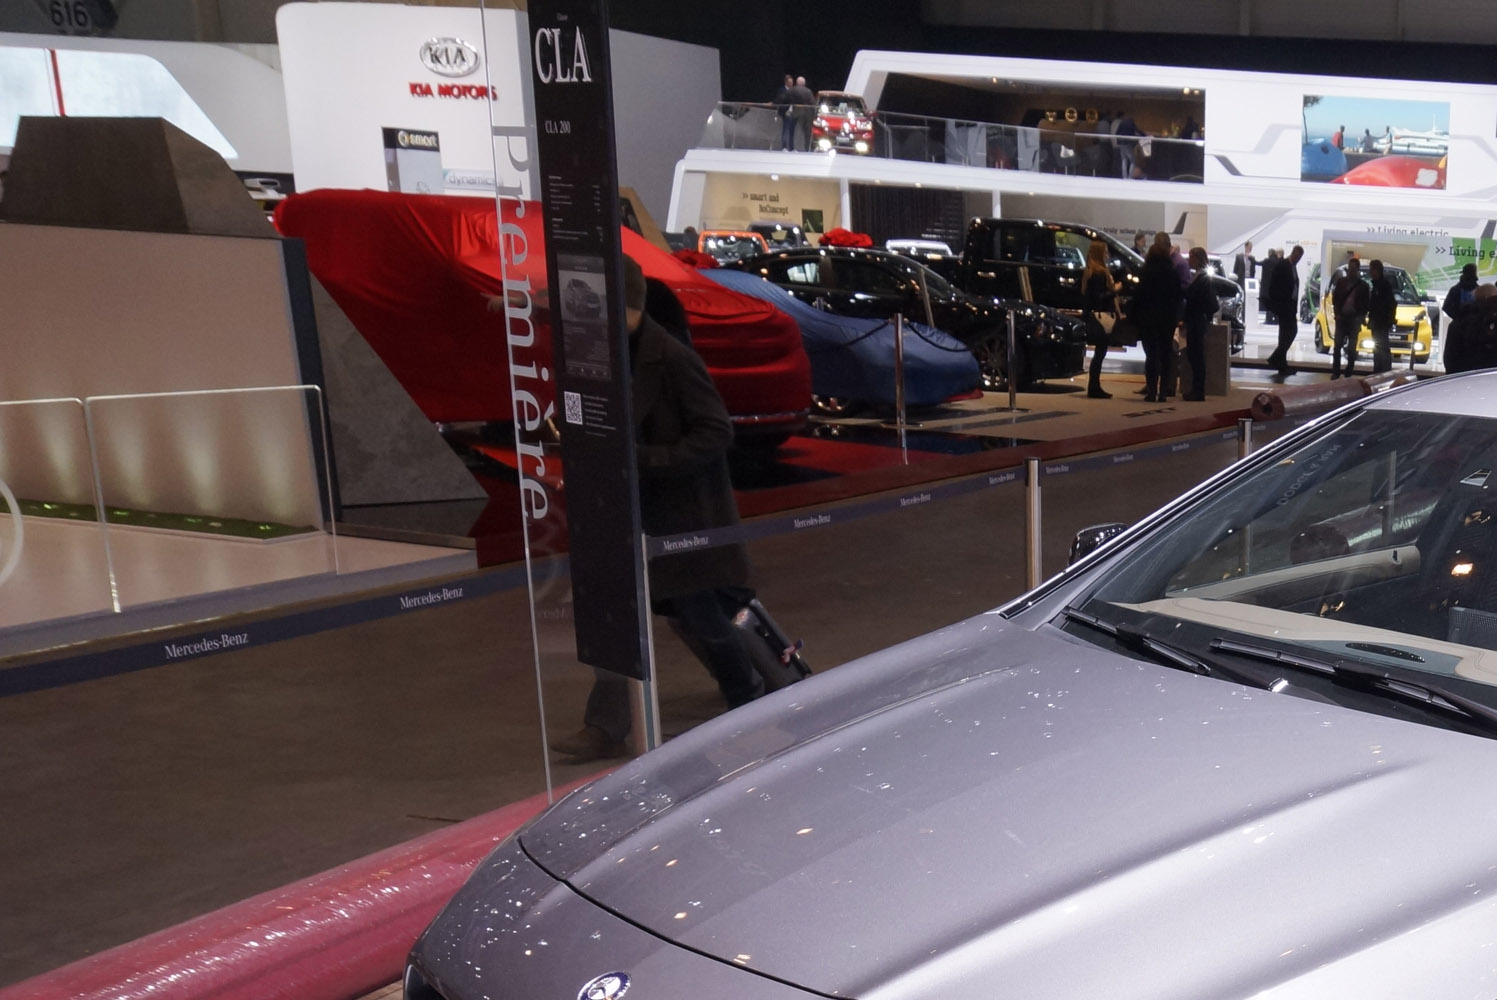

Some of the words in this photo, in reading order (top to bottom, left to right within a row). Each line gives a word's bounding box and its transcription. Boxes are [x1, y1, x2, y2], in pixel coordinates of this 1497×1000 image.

[51, 0, 88, 28] 616
[535, 25, 592, 84] CLA
[409, 82, 434, 98] KIA
[437, 83, 498, 101] MOTORS
[545, 120, 559, 134] CLA
[560, 120, 571, 134] 200
[410, 133, 438, 147] smart
[1449, 246, 1485, 259] Living
[491, 125, 555, 521] Première
[794, 514, 831, 529] Mercedes-Benz
[663, 535, 709, 551] Mercedes-Benz
[400, 586, 464, 610] Mercedes-Benz
[164, 631, 249, 660] Mercedes-Benz
